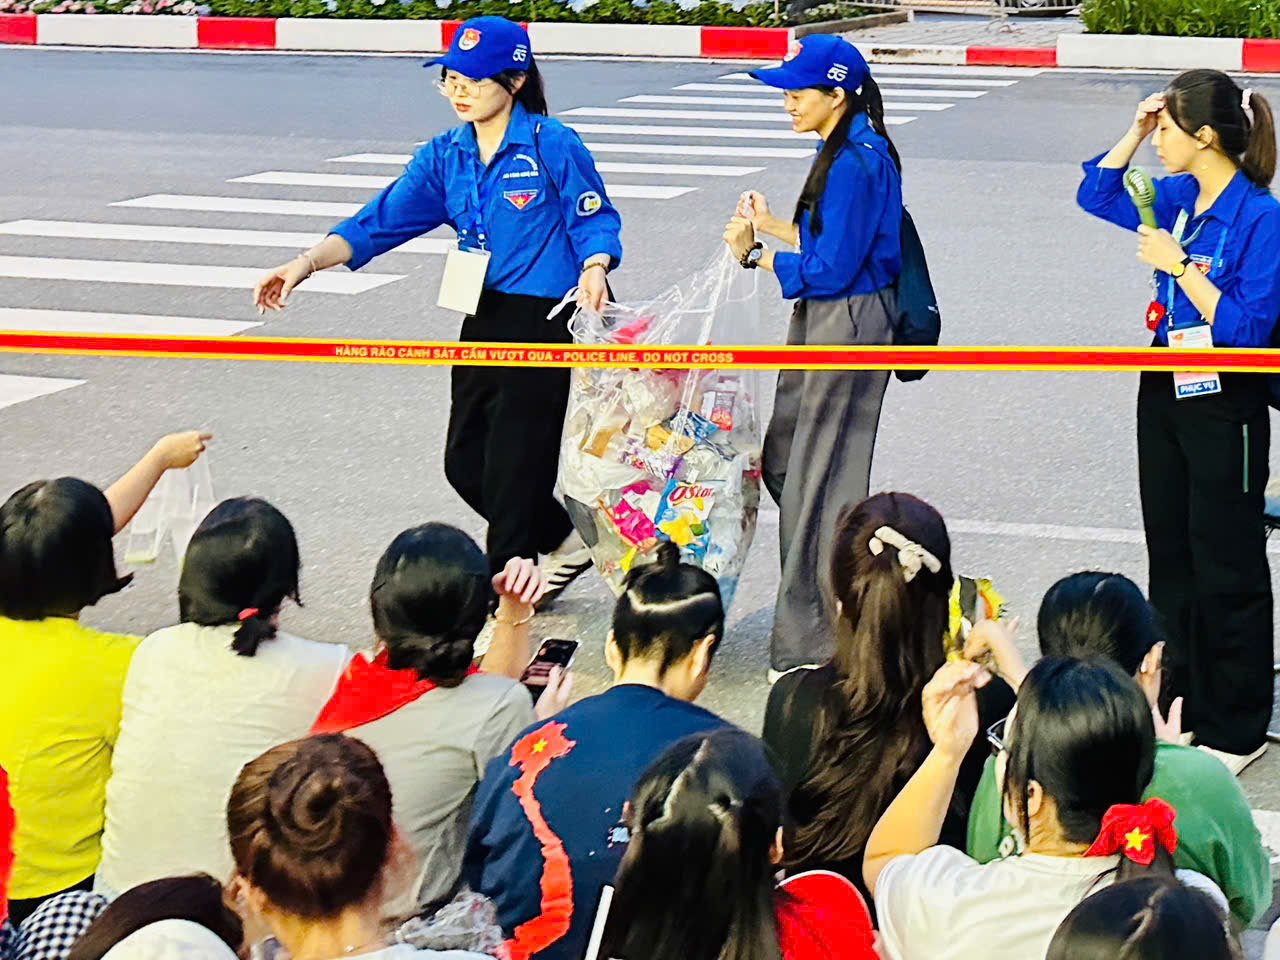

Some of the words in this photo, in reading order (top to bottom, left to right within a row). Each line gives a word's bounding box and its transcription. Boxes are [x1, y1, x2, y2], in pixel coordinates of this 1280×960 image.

[826, 66, 848, 82] 5G
[335, 345, 369, 358] HÀNG
[370, 346, 396, 359] RÀO
[527, 350, 553, 362] QUA
[563, 351, 606, 363] POLICE
[643, 352, 660, 363] DO
[664, 352, 689, 363] NOT
[691, 352, 735, 363] CROSS
